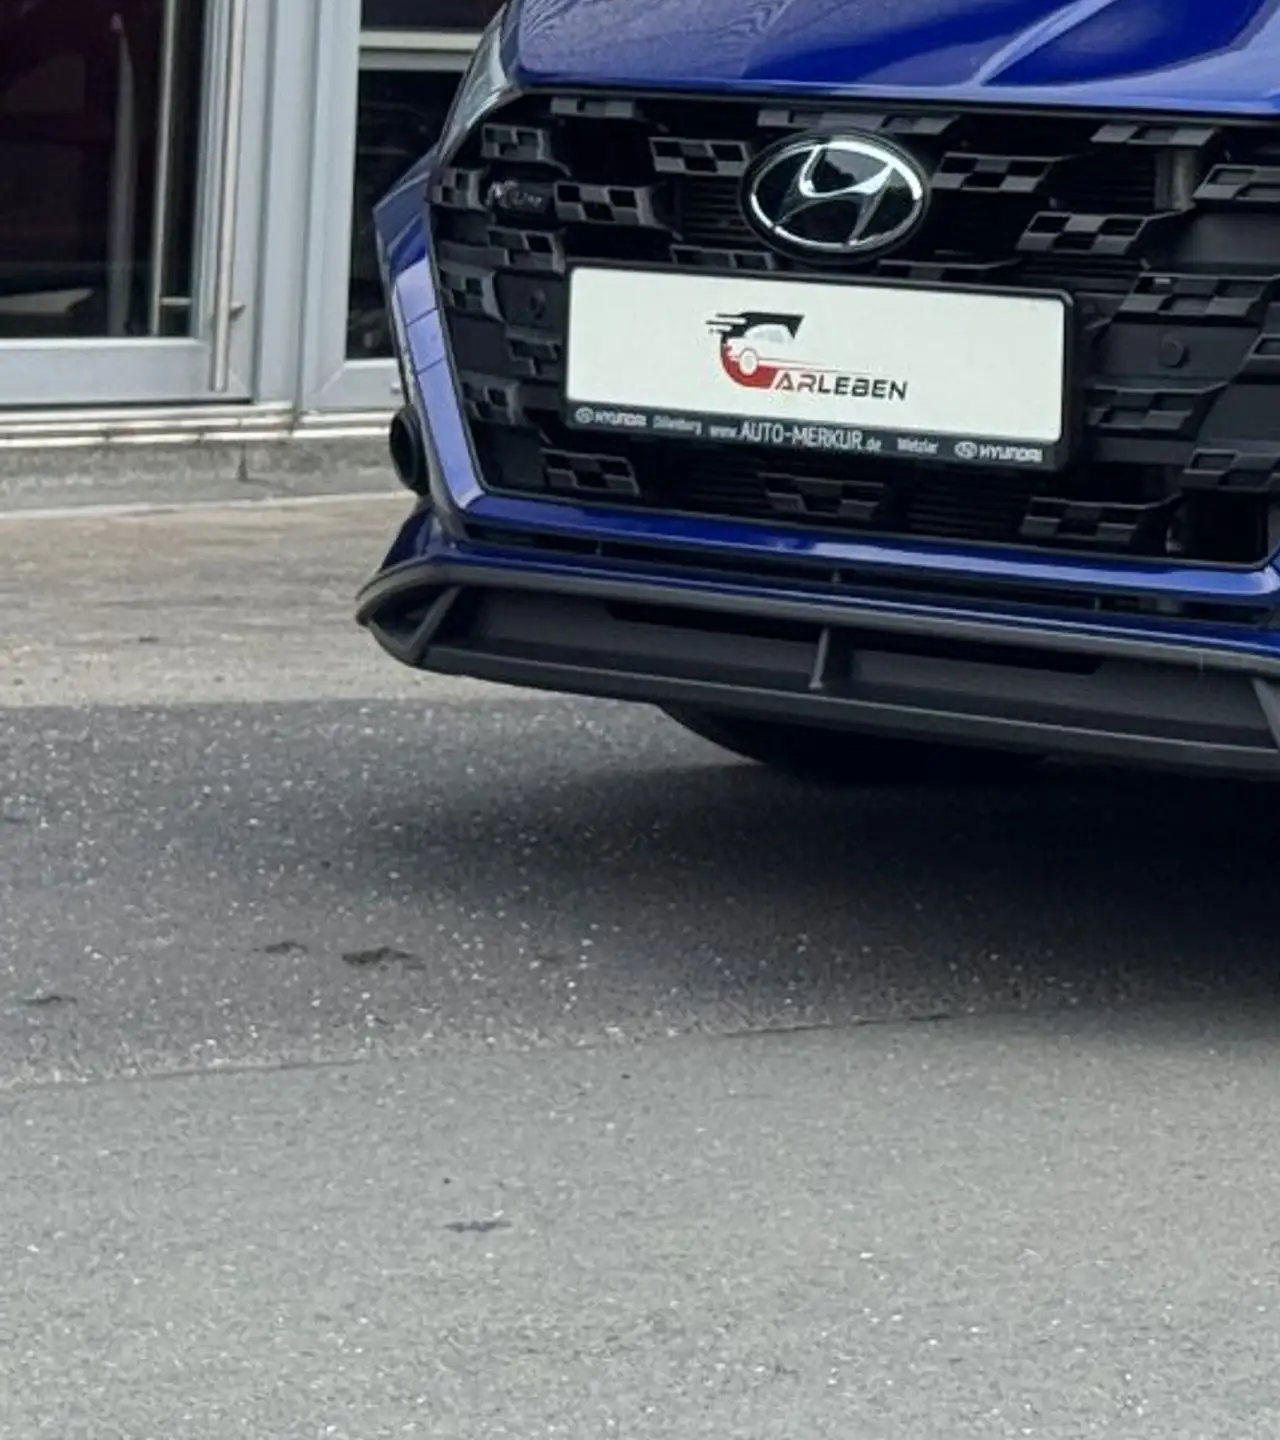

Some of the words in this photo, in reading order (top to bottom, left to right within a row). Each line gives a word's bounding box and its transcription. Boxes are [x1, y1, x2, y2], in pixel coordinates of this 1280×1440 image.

[595, 411, 648, 428] HYUNDAI
[709, 421, 883, 453] www.AUTO-MERKUR.de
[979, 444, 1044, 463] HYUNDAI
